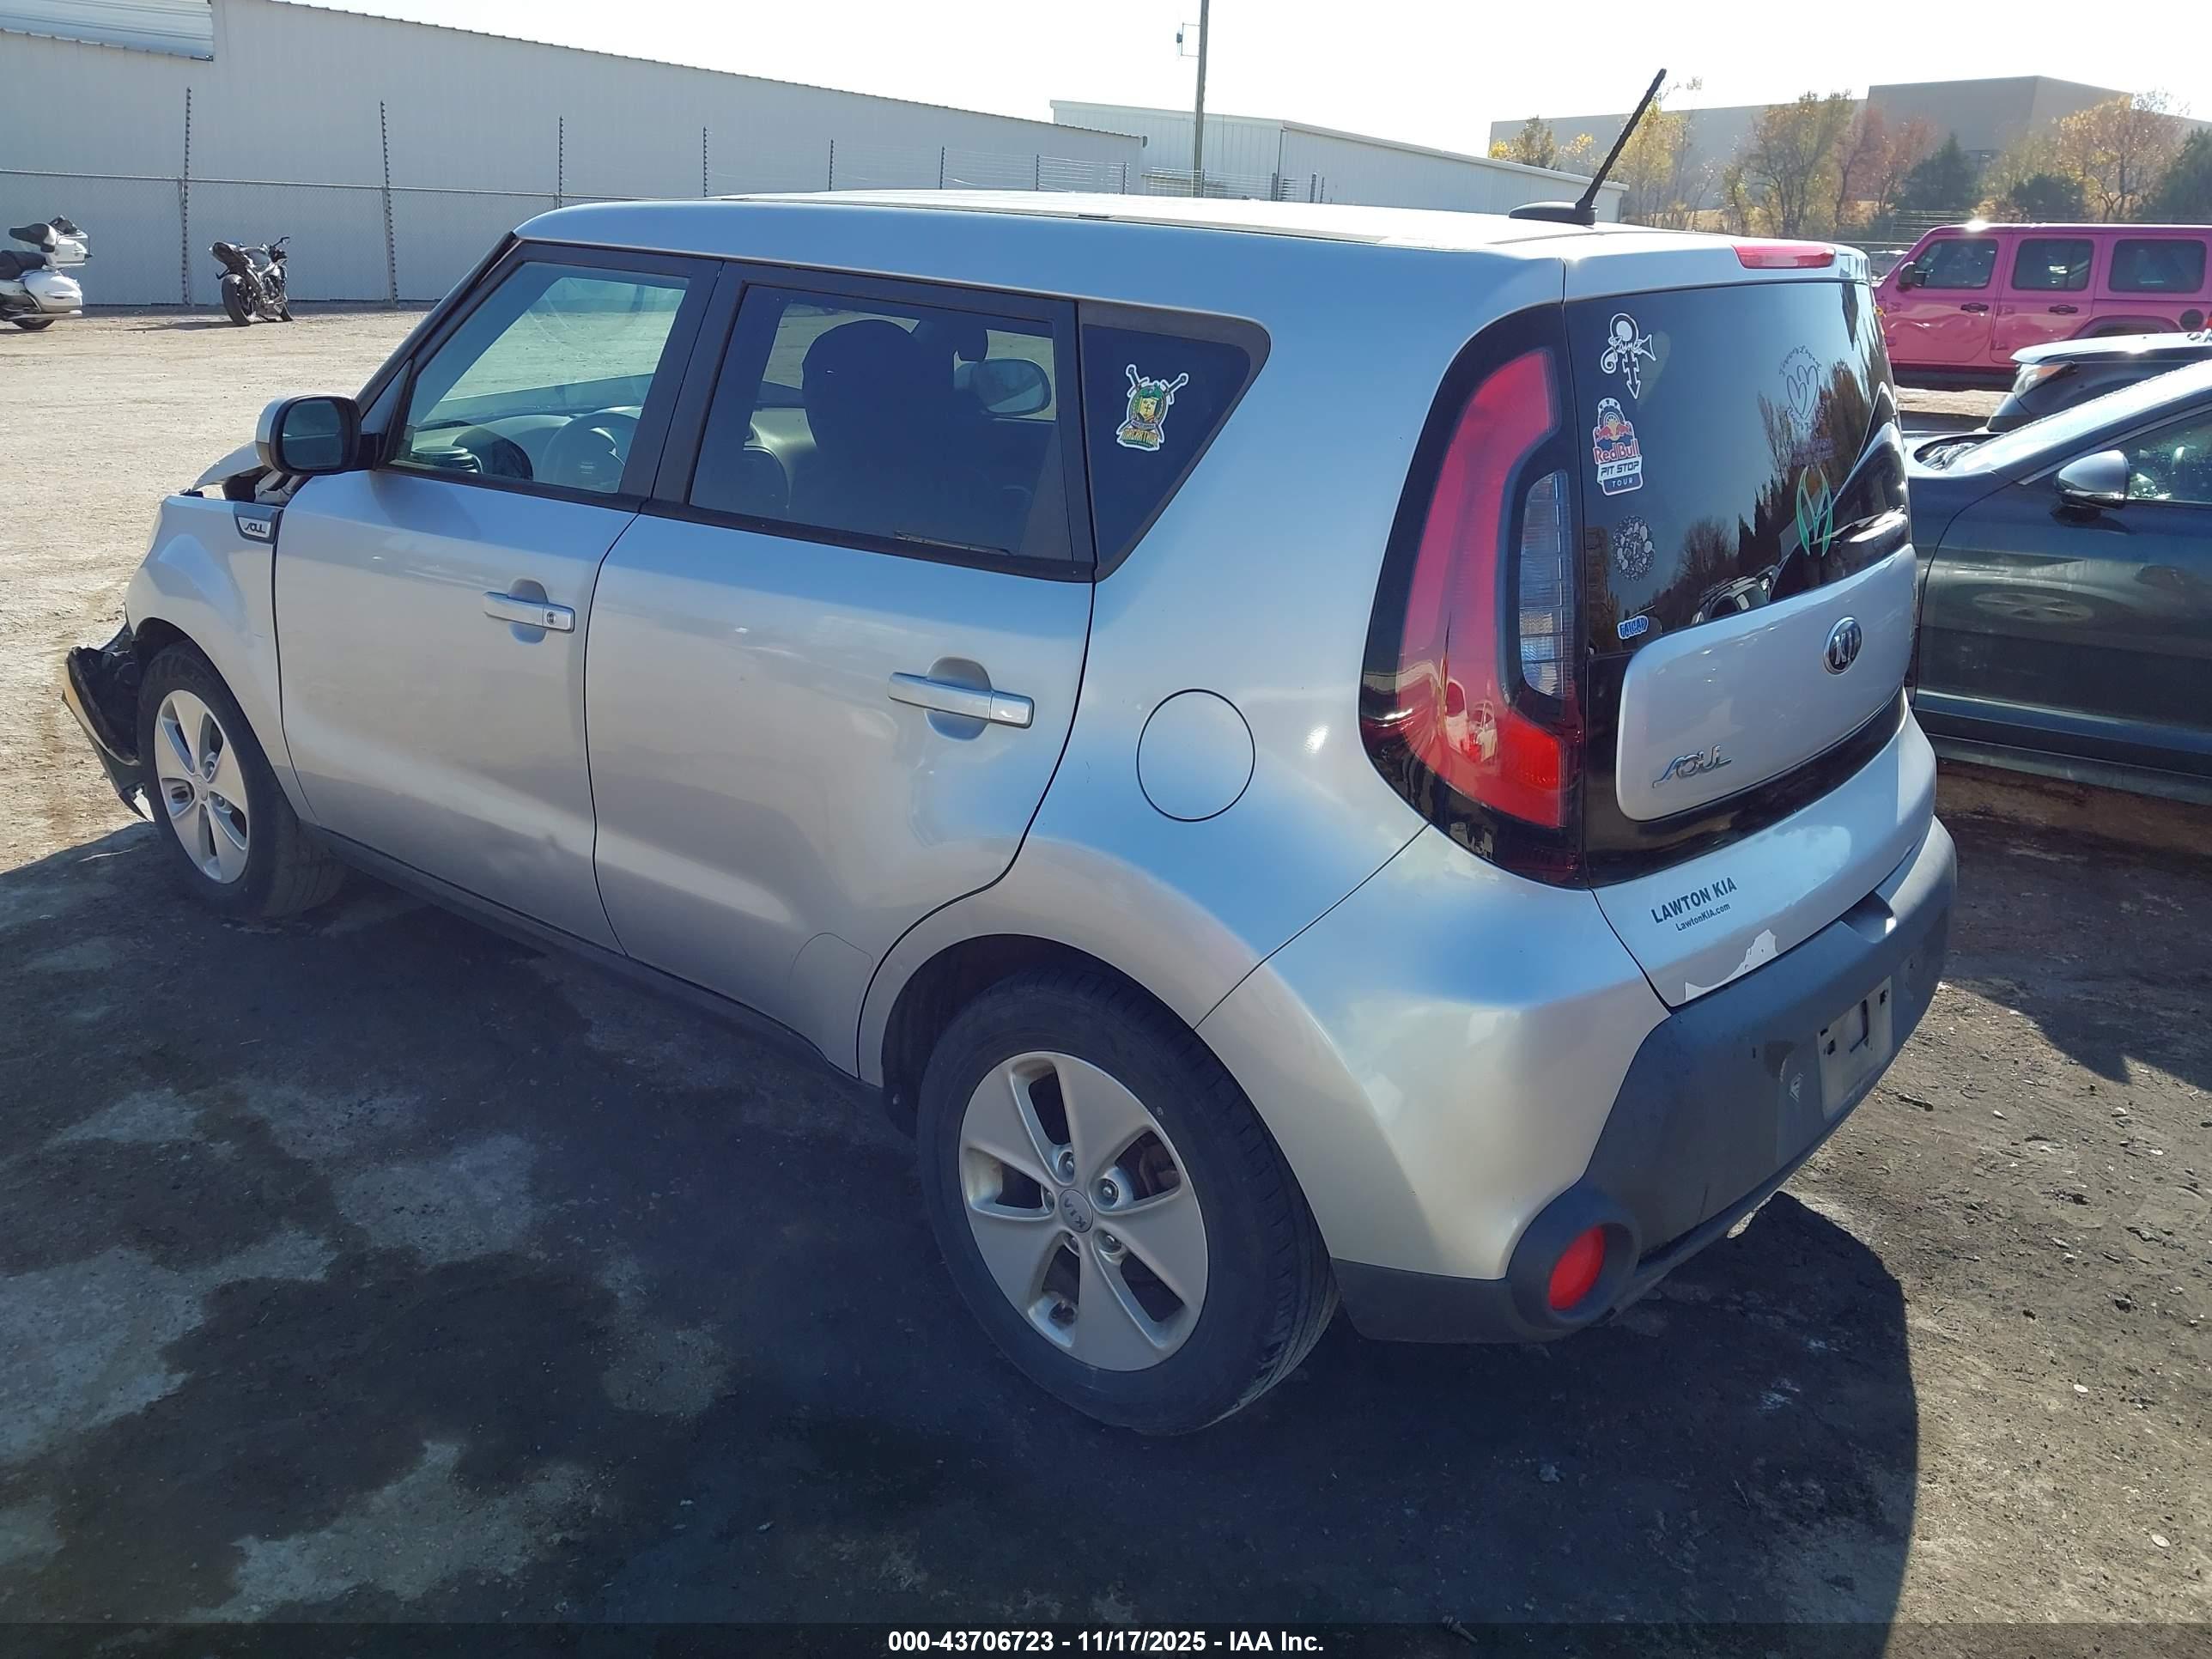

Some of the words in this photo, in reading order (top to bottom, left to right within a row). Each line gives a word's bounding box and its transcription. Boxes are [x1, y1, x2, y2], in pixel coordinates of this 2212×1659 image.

[1601, 465, 1615, 477] PIT
[1616, 460, 1639, 474] STOP
[1612, 477, 1634, 488] TOUR
[1650, 887, 1712, 924] LAWTON
[1711, 877, 1738, 898] KIA
[1674, 902, 1732, 932] LawtonKIA.com
